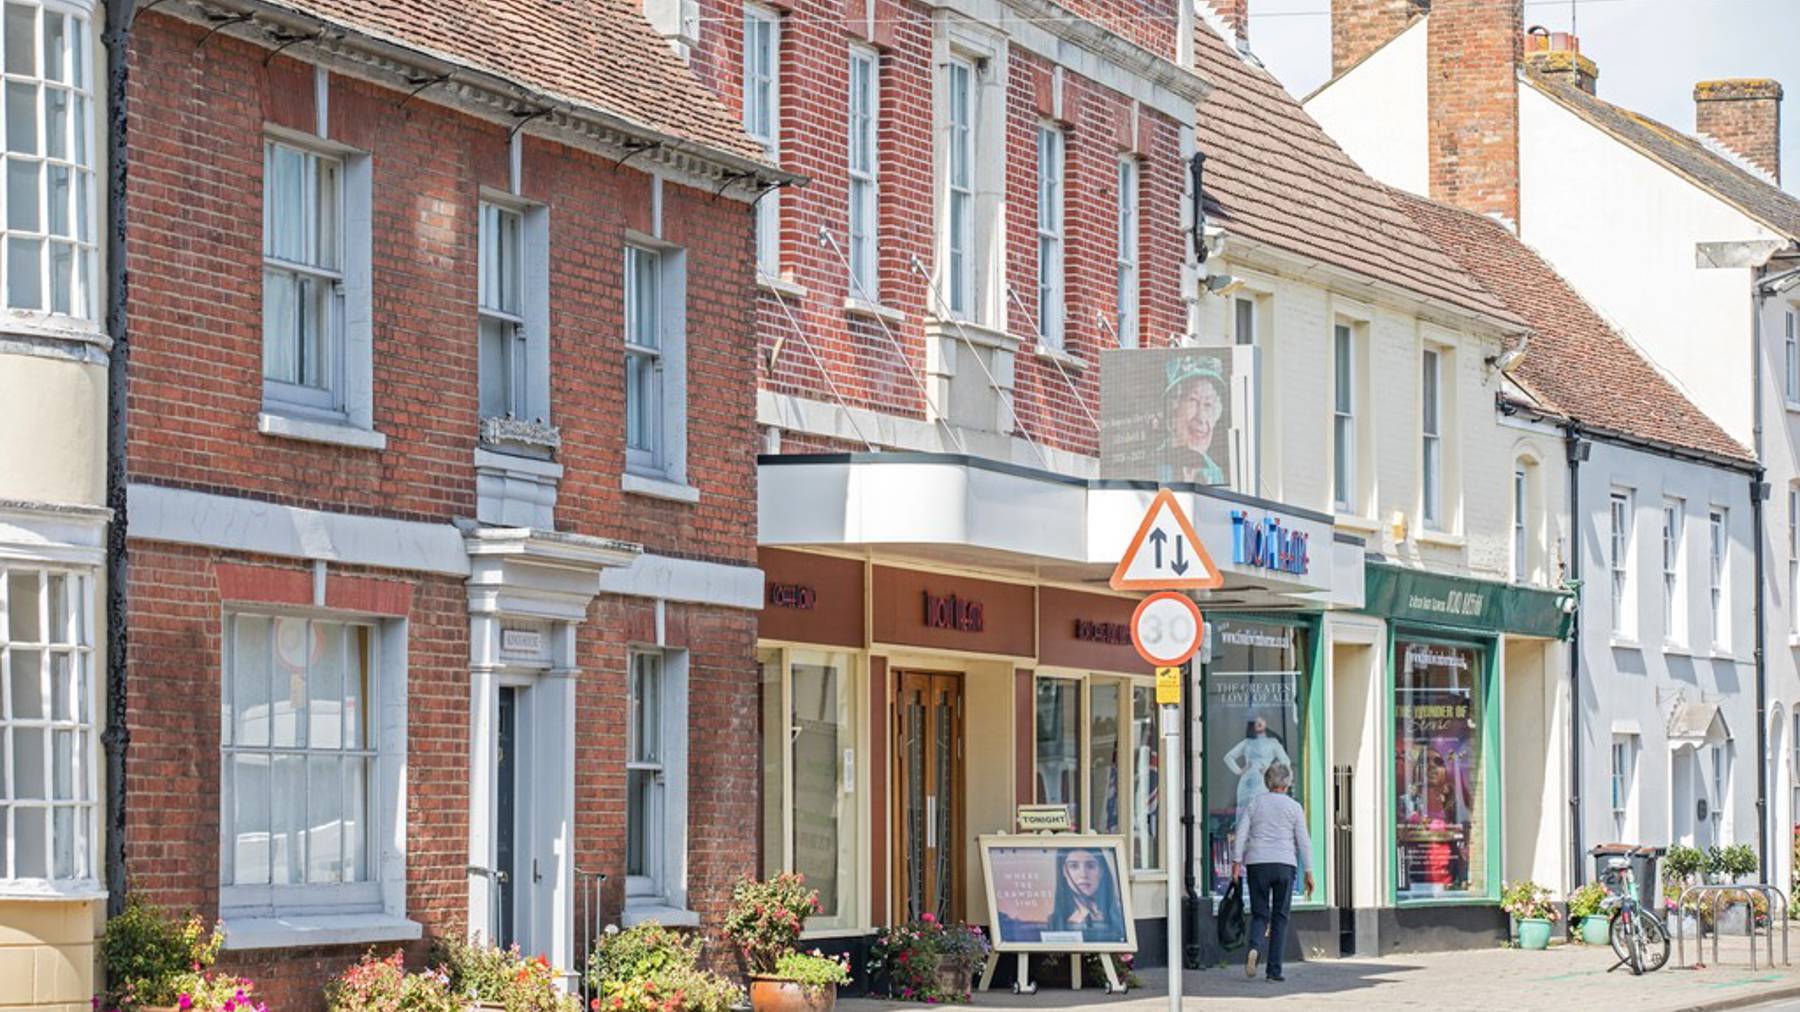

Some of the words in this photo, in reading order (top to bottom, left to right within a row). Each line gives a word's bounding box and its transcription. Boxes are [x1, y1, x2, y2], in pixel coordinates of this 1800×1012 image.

[1144, 614, 1190, 643] 30
[1022, 815, 1065, 824] TONIGHT
[1004, 871, 1039, 880] WHERE
